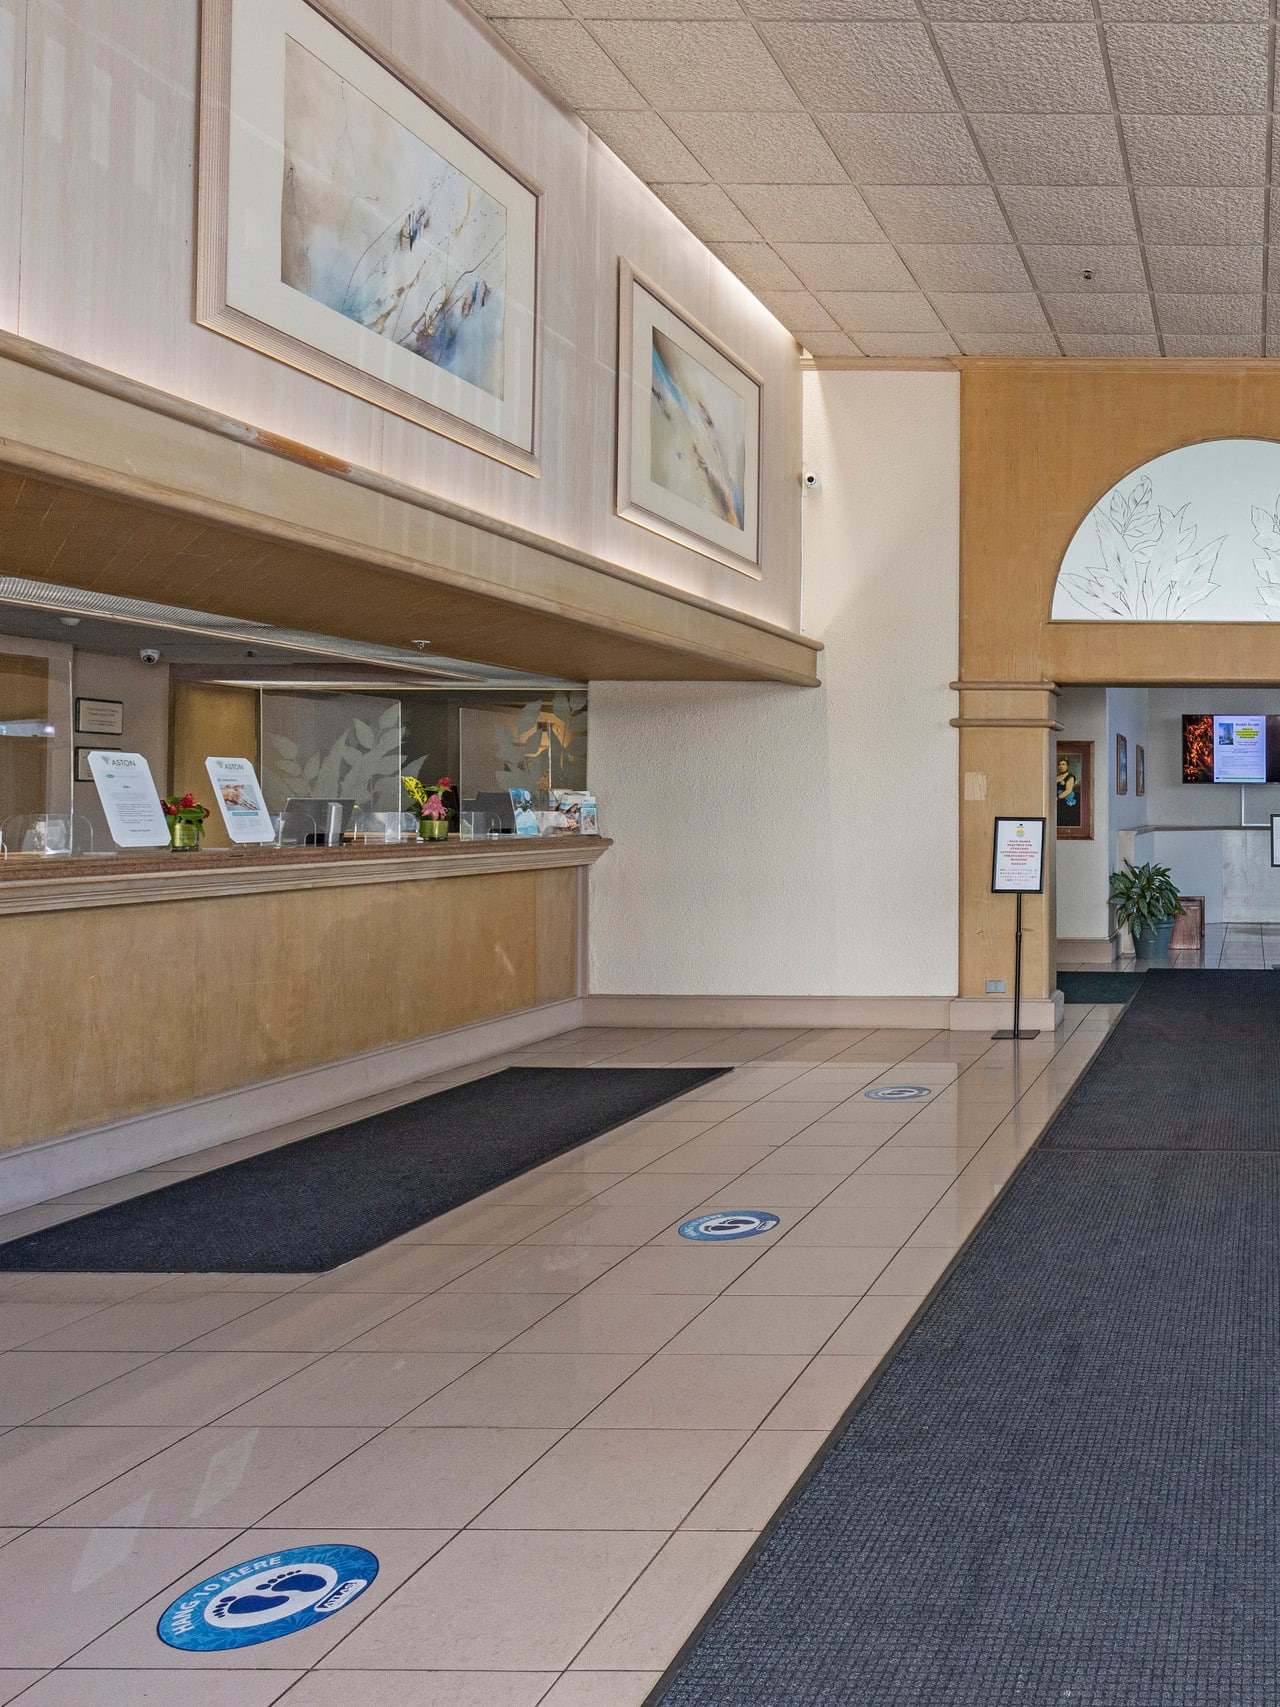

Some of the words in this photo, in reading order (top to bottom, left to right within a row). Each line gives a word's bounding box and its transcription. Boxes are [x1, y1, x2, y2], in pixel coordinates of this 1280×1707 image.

[111, 759, 136, 767] ASTON
[172, 1598, 200, 1636] HANG
[193, 1582, 221, 1600] 10
[219, 1555, 283, 1585] HERE
